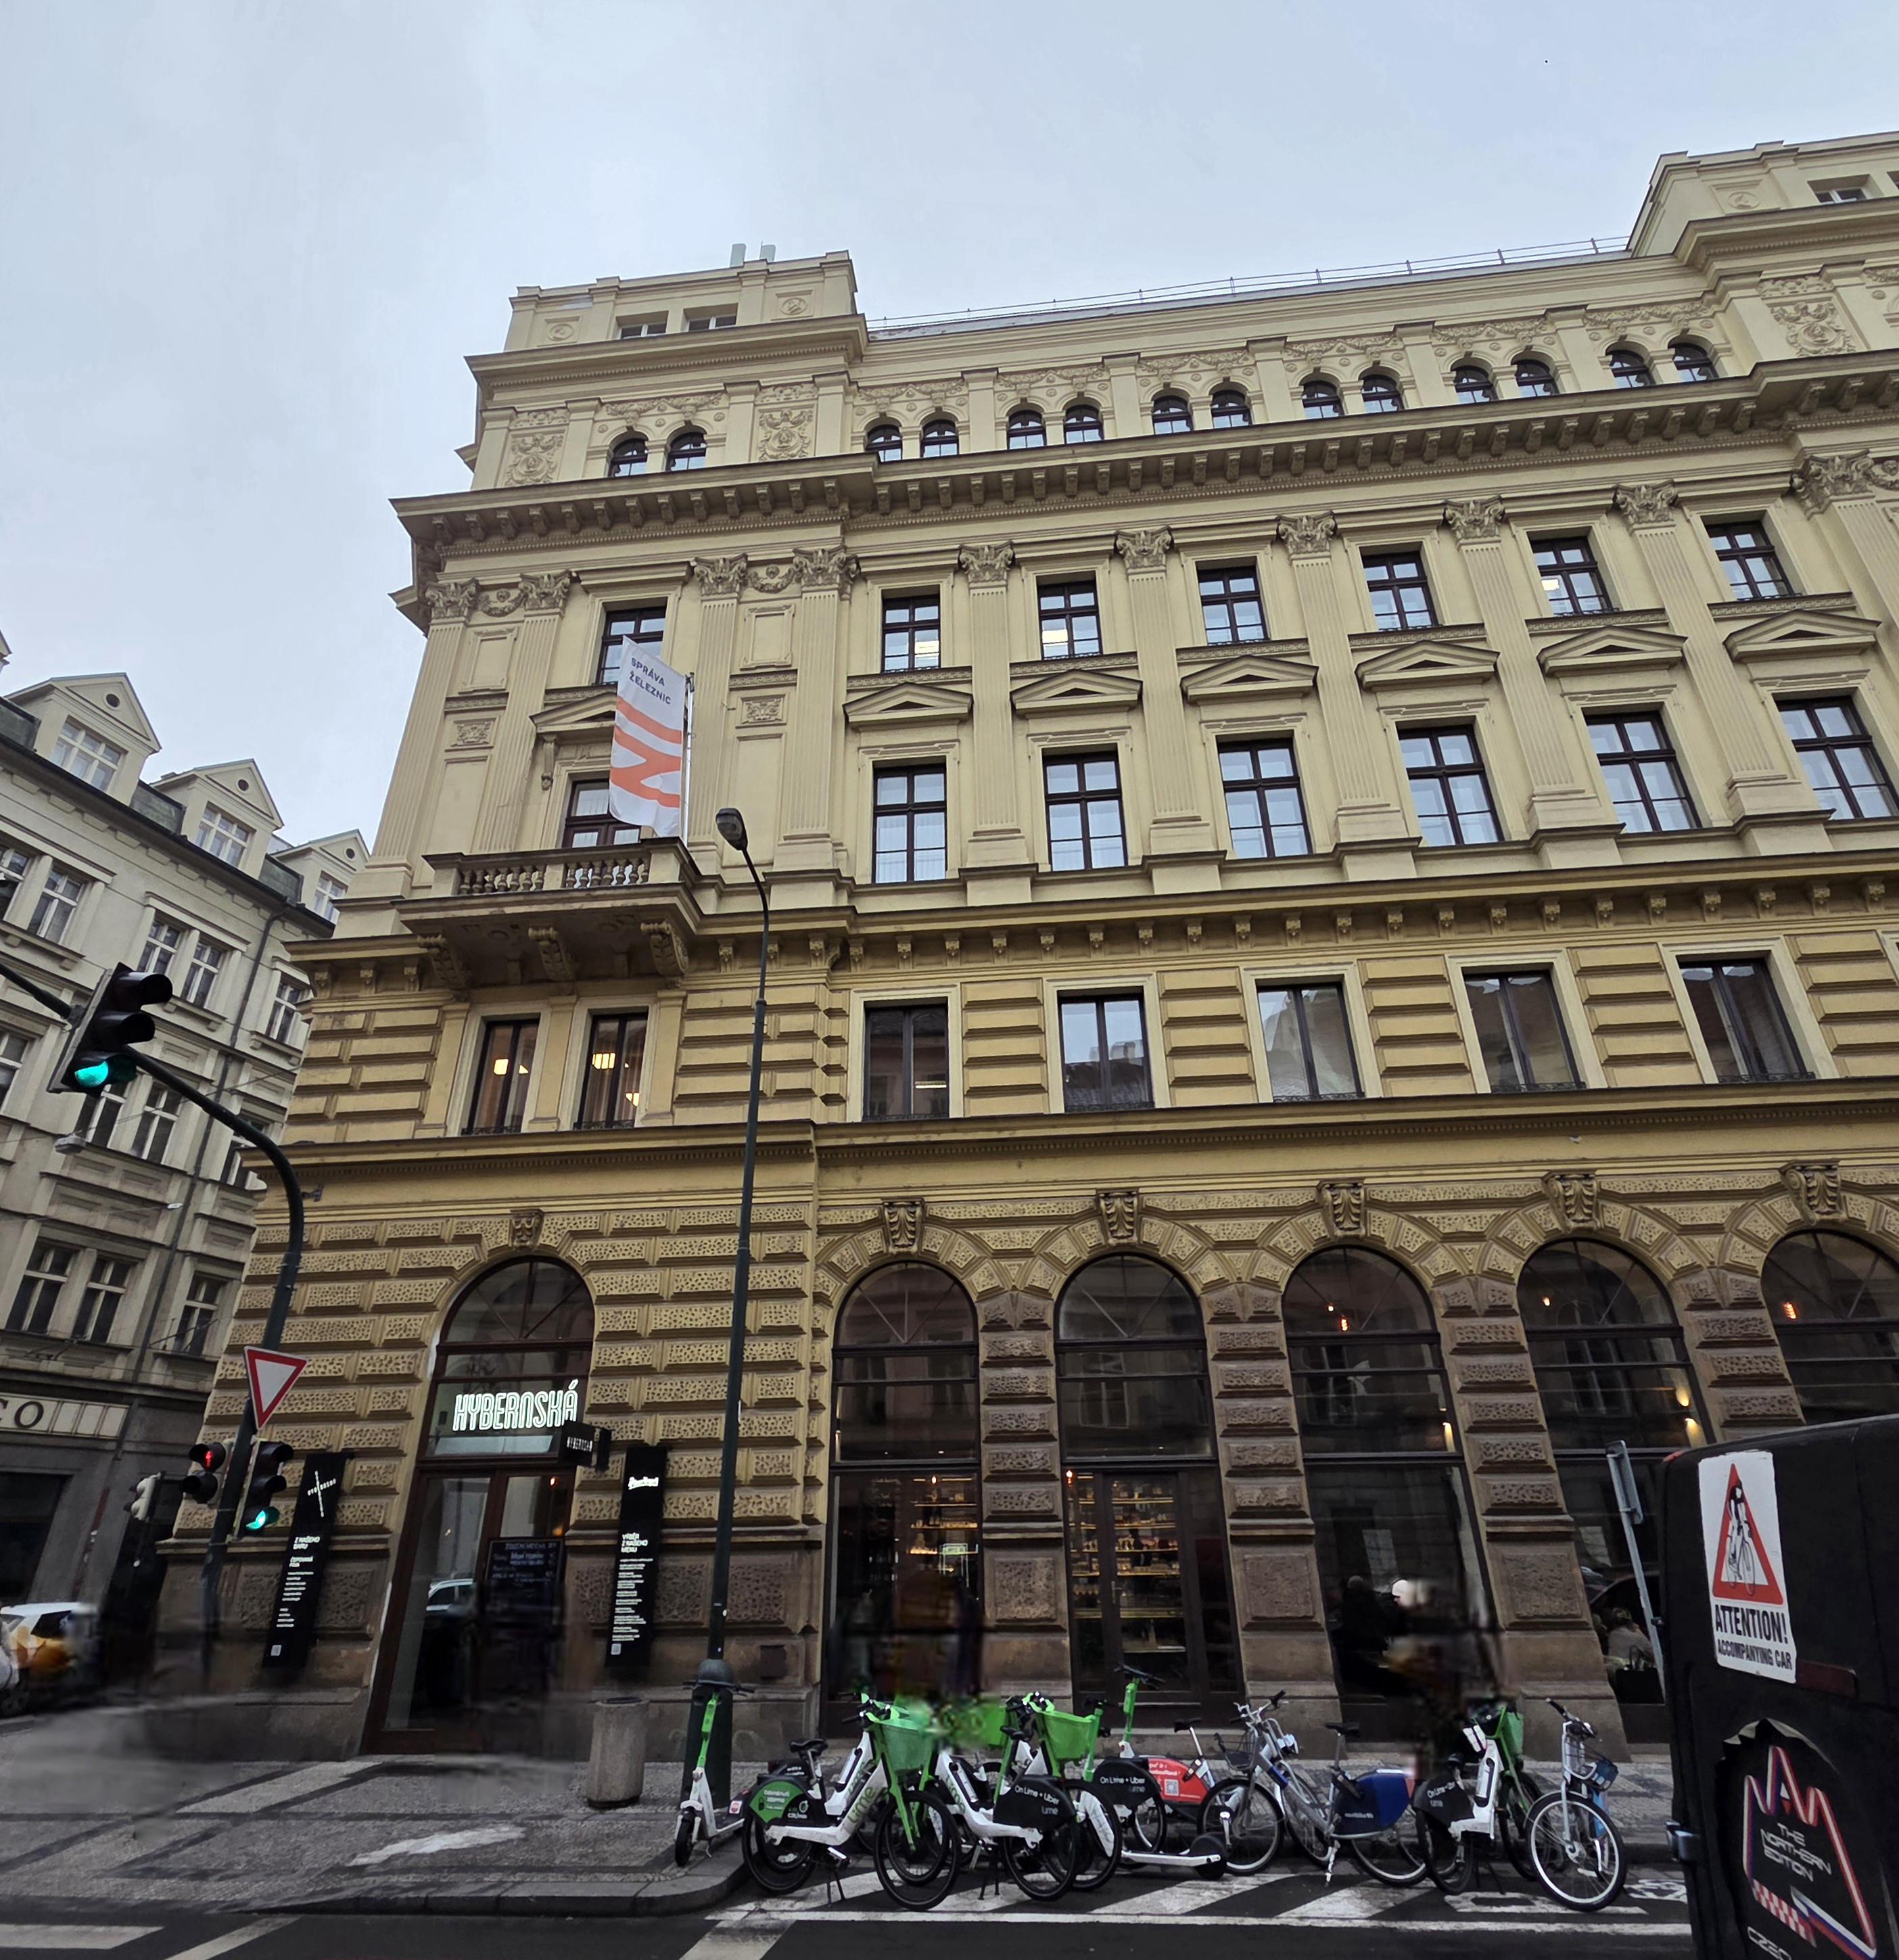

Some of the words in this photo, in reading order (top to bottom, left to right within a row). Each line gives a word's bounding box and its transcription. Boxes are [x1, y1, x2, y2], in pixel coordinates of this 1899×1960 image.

[630, 671, 672, 705] ŽELEZNIC
[631, 657, 665, 686] SPRÁVA
[452, 1379, 578, 1431] HYBERNSKÁ
[1715, 1604, 1788, 1644] ATTENTION!
[1718, 1639, 1774, 1666] ACCOMPANYING
[1775, 1650, 1792, 1671] CAR
[847, 1786, 876, 1823] Lime
[1015, 1785, 1024, 1794] On
[1024, 1786, 1038, 1797] Lime
[1044, 1793, 1060, 1804] Uber
[1041, 1806, 1059, 1815] Lime
[1777, 1823, 1806, 1846] THE
[1760, 1829, 1832, 1875] NORTHERN
[1764, 1846, 1814, 1882] EDITION
